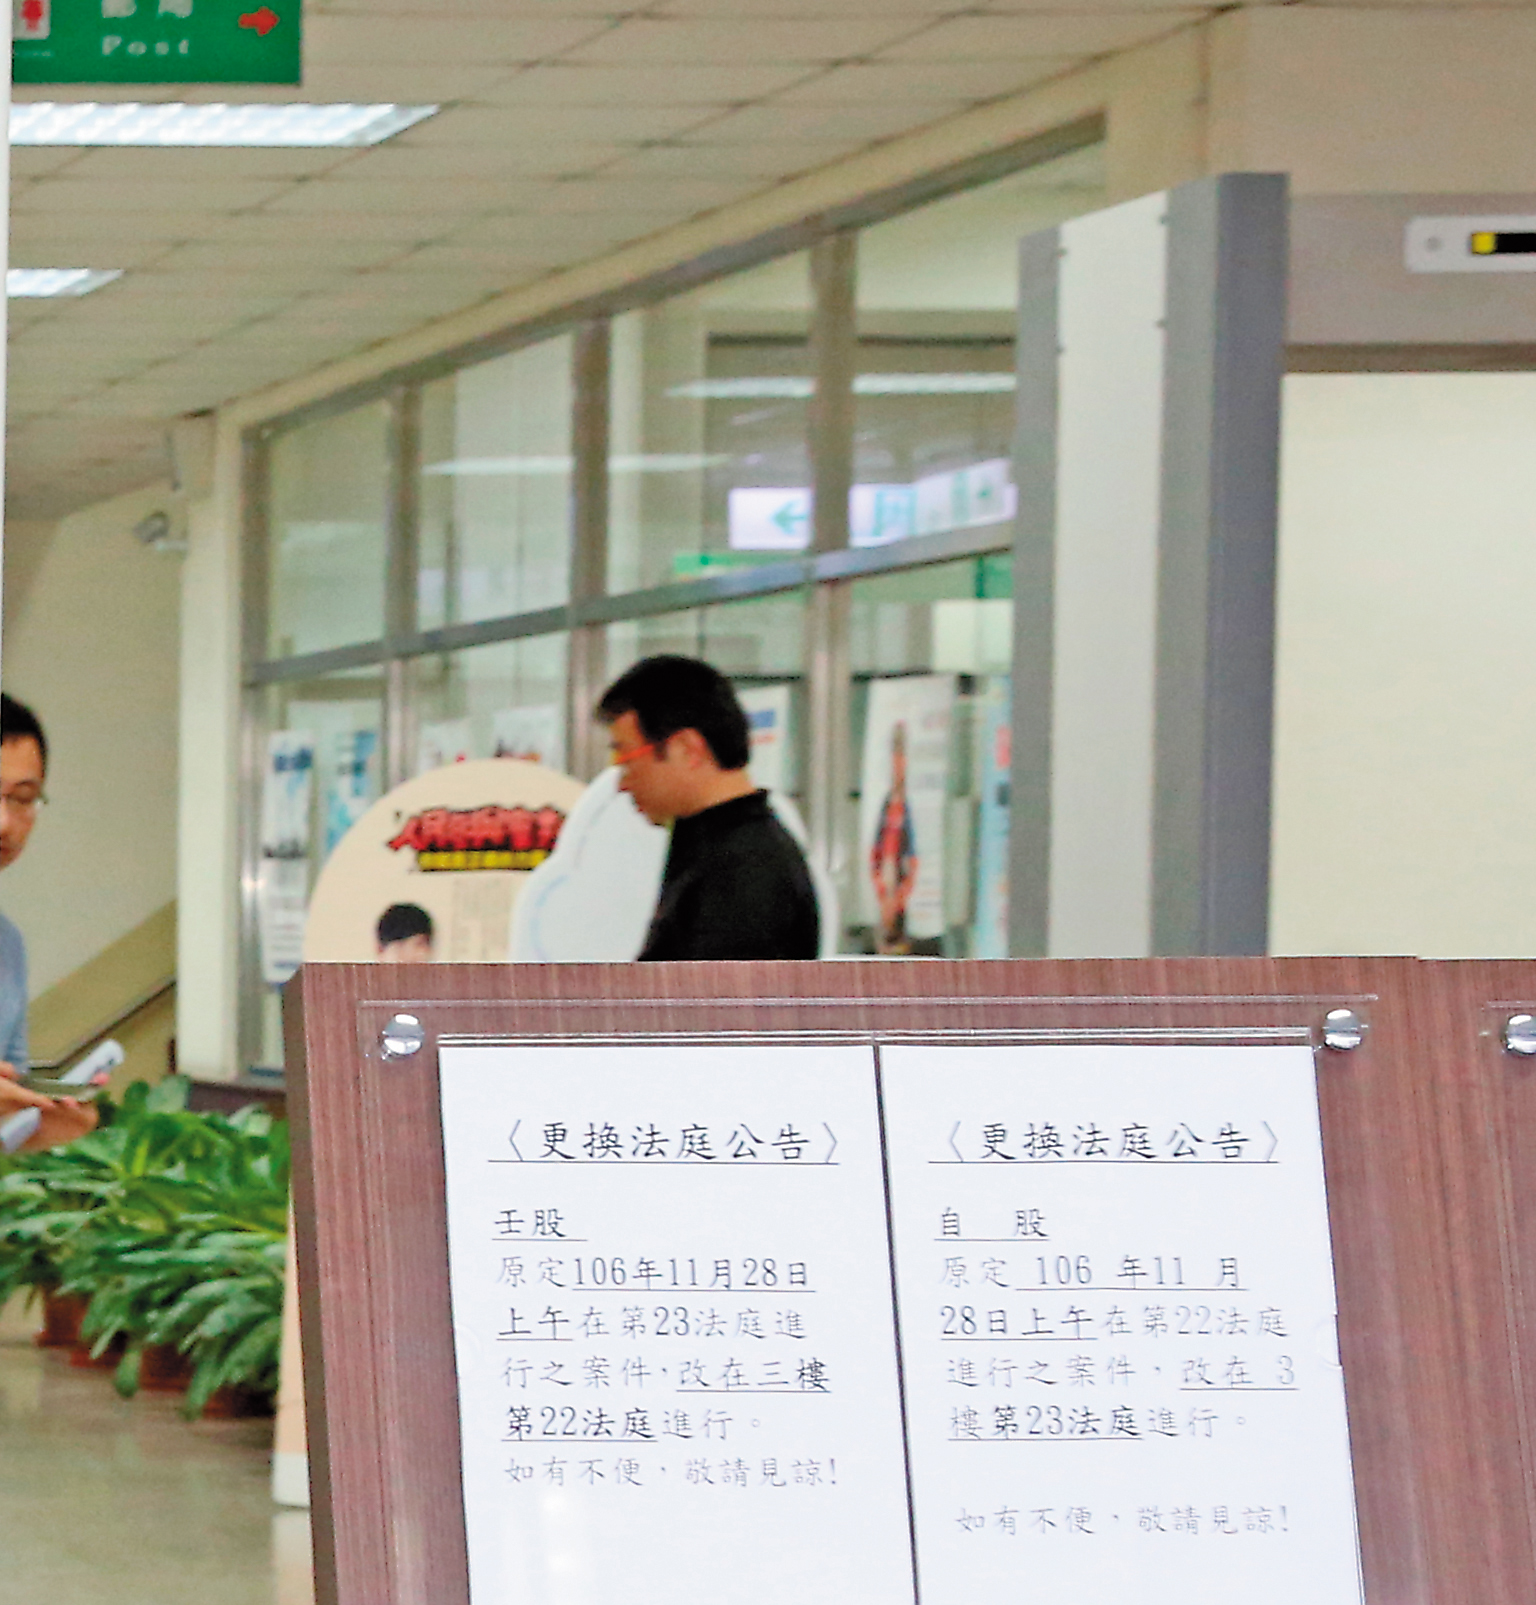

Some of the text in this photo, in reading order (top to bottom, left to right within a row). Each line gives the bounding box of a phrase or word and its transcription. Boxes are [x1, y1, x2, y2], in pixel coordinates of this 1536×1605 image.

[497, 1256, 809, 1289] 原定106年11月28日
[499, 1305, 808, 1338] 上午在第23法庭進
[941, 1305, 1290, 1338] 28日上午在第22法庭
[506, 1405, 762, 1440] 第22法庭進行。
